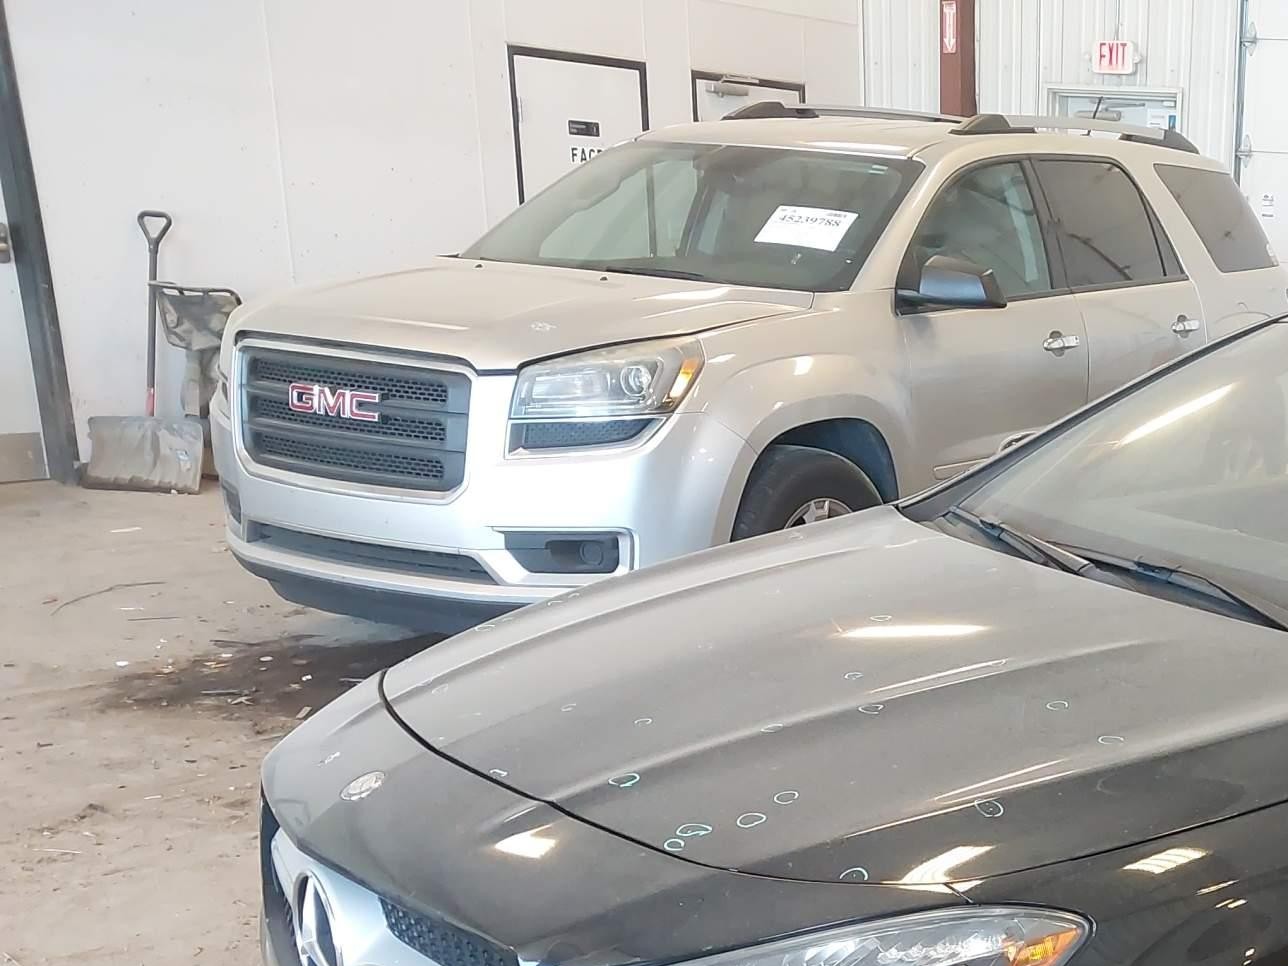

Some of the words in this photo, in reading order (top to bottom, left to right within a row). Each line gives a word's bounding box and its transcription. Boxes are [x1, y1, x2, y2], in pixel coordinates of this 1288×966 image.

[1099, 42, 1128, 66] EXIT
[779, 214, 841, 227] 45239788
[288, 382, 379, 422] GMC
